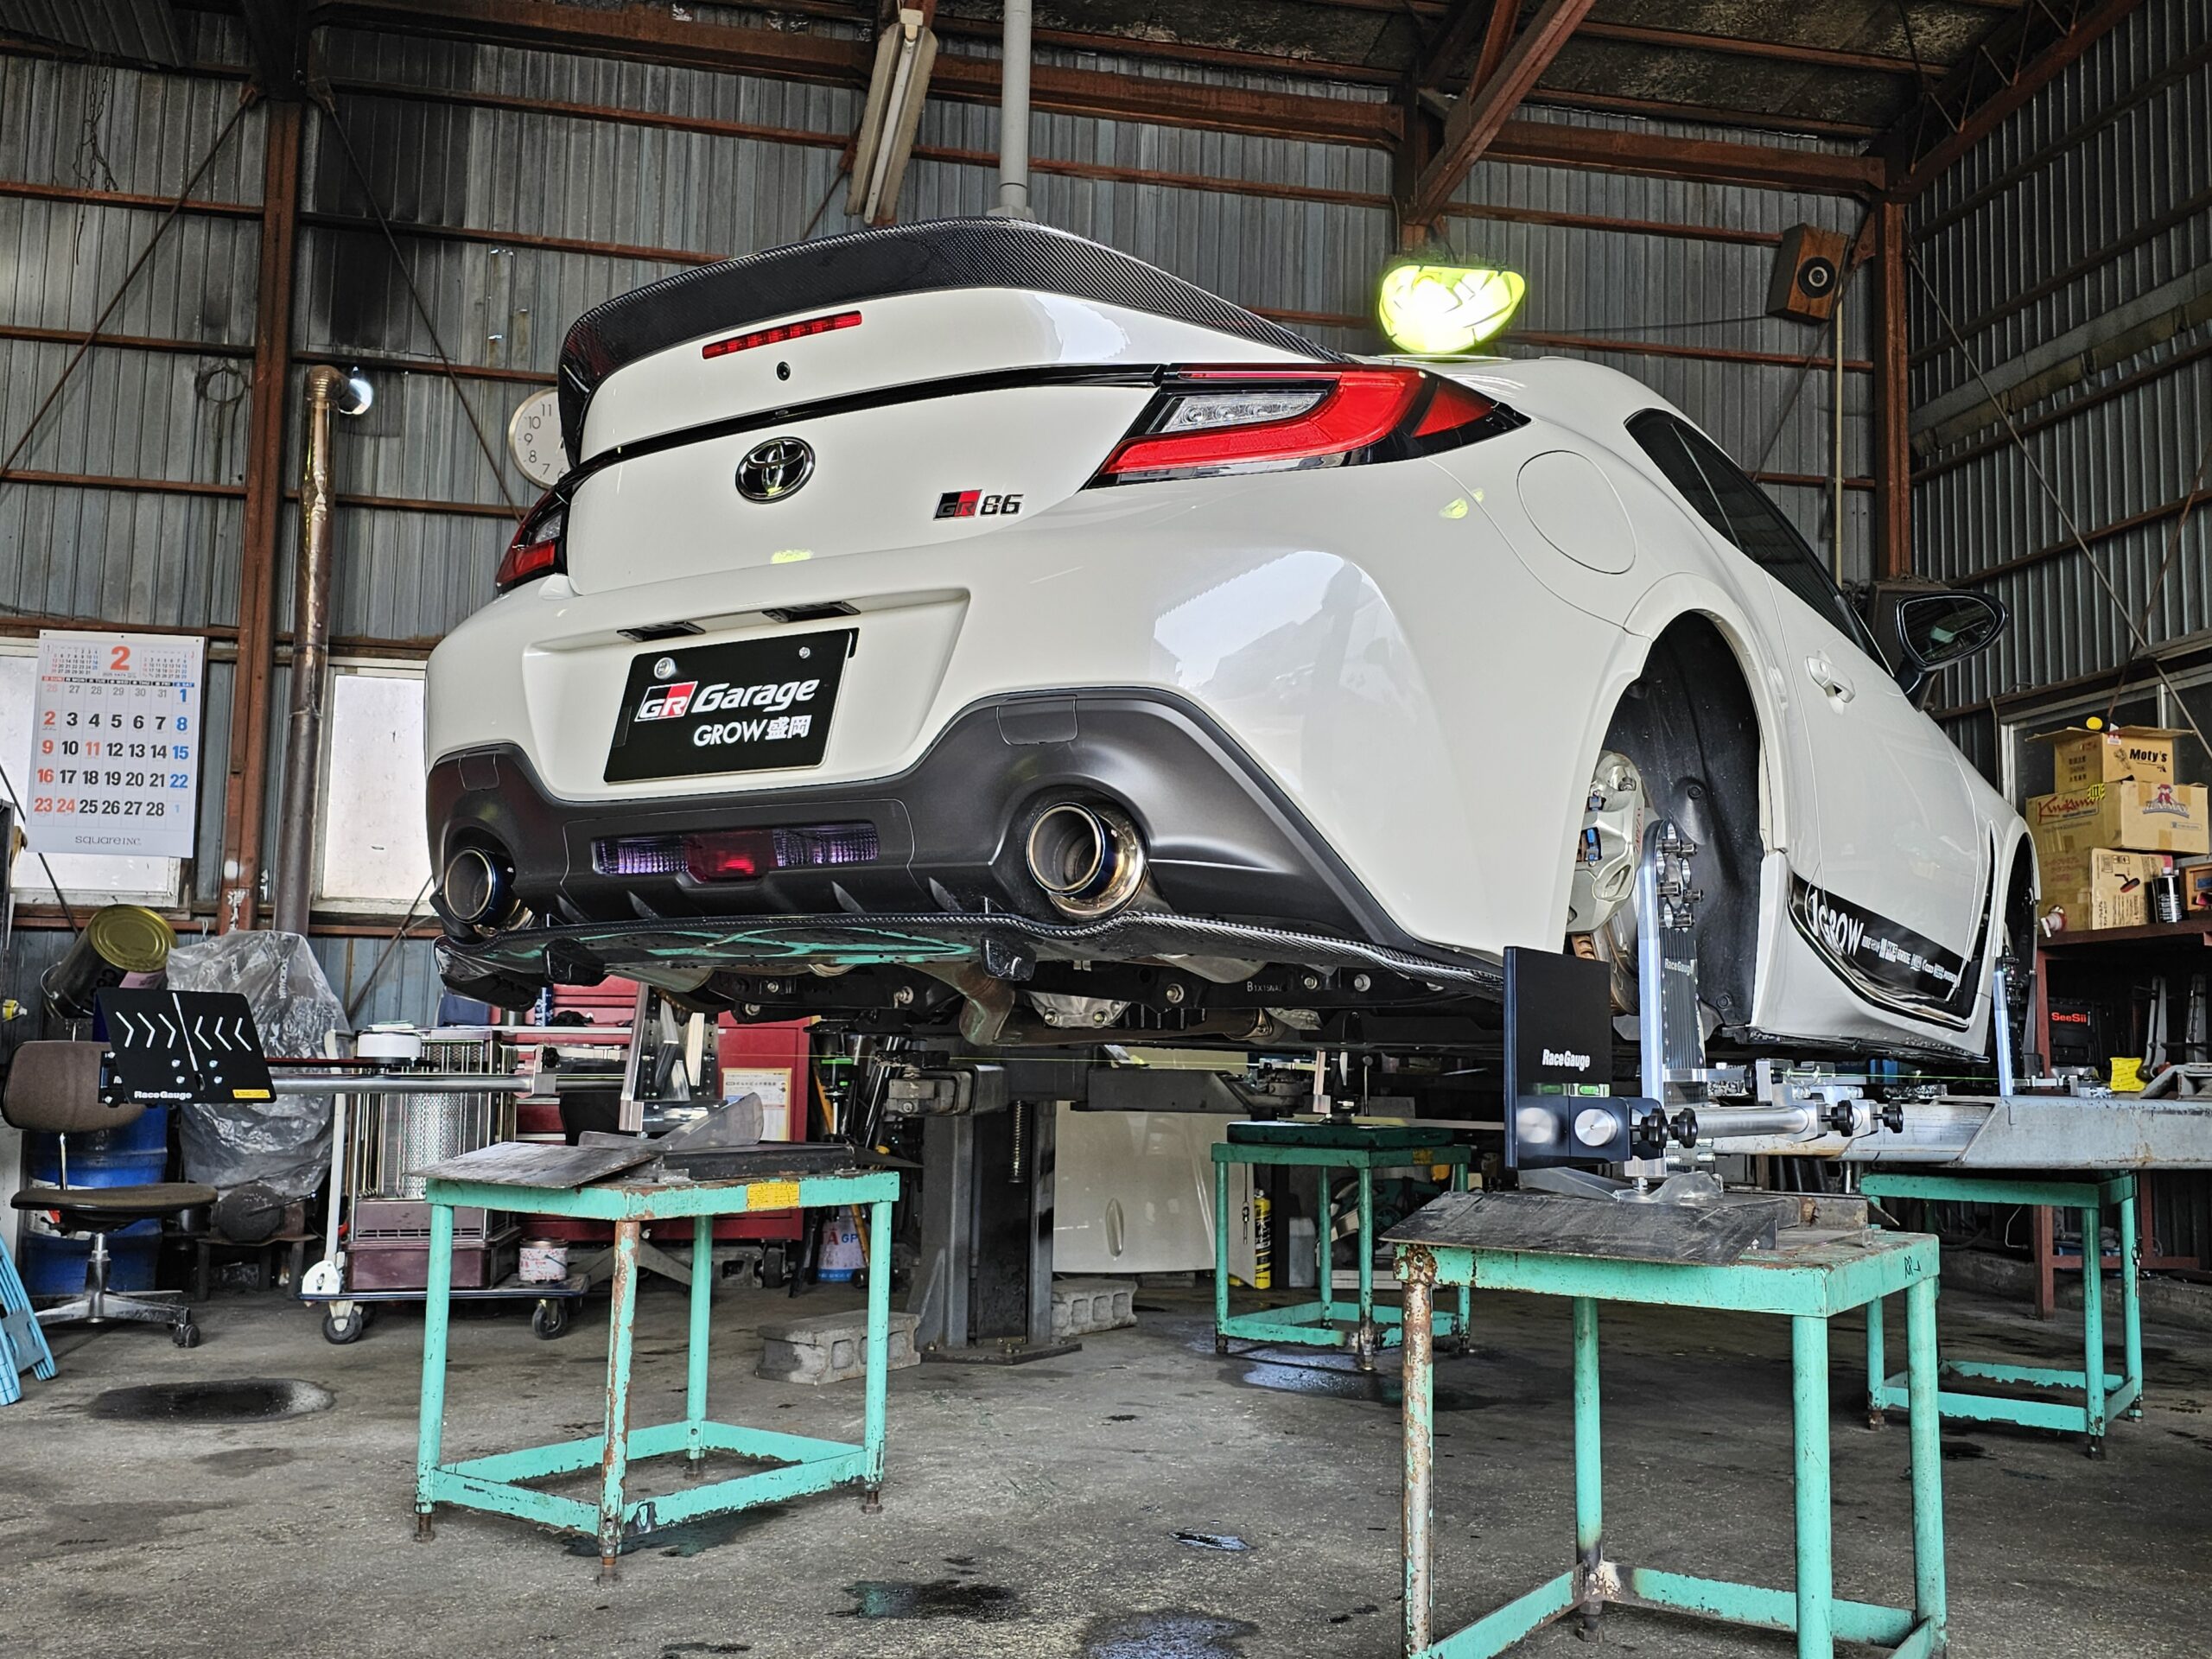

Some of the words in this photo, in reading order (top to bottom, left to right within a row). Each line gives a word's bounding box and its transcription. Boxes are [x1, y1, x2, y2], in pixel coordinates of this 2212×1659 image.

[541, 404, 551, 416] 11
[528, 416, 541, 429] 10
[524, 432, 533, 446] 9
[528, 449, 537, 463] 8
[542, 463, 550, 474] 7
[980, 493, 1024, 515] 86
[110, 645, 130, 671] 2
[179, 689, 187, 702] 1
[691, 679, 820, 713] Garage
[44, 711, 55, 725] 2
[67, 712, 78, 726] 3
[88, 714, 100, 728] 4
[111, 715, 122, 728] 5
[133, 715, 144, 729] 6
[156, 716, 166, 730] 7
[176, 717, 188, 731] 8
[41, 740, 54, 754] 9
[62, 741, 79, 755] 10
[86, 741, 100, 756] 11
[106, 742, 124, 757] 12
[129, 744, 145, 758] 13
[150, 745, 167, 759] 14
[172, 746, 189, 760] 15
[2129, 748, 2167, 763] Moty's
[37, 769, 54, 783] 16
[60, 770, 77, 784] 17
[82, 771, 99, 785] 18
[105, 772, 121, 786] 19
[125, 772, 143, 786] 20
[149, 773, 165, 787] 21
[169, 774, 188, 788] 22
[35, 798, 53, 812] 23
[56, 798, 75, 813] 24
[79, 799, 98, 814] 25
[101, 800, 120, 814] 26
[124, 801, 143, 815] 27
[146, 802, 165, 817] 28
[2051, 1012, 2088, 1023] SeeSii
